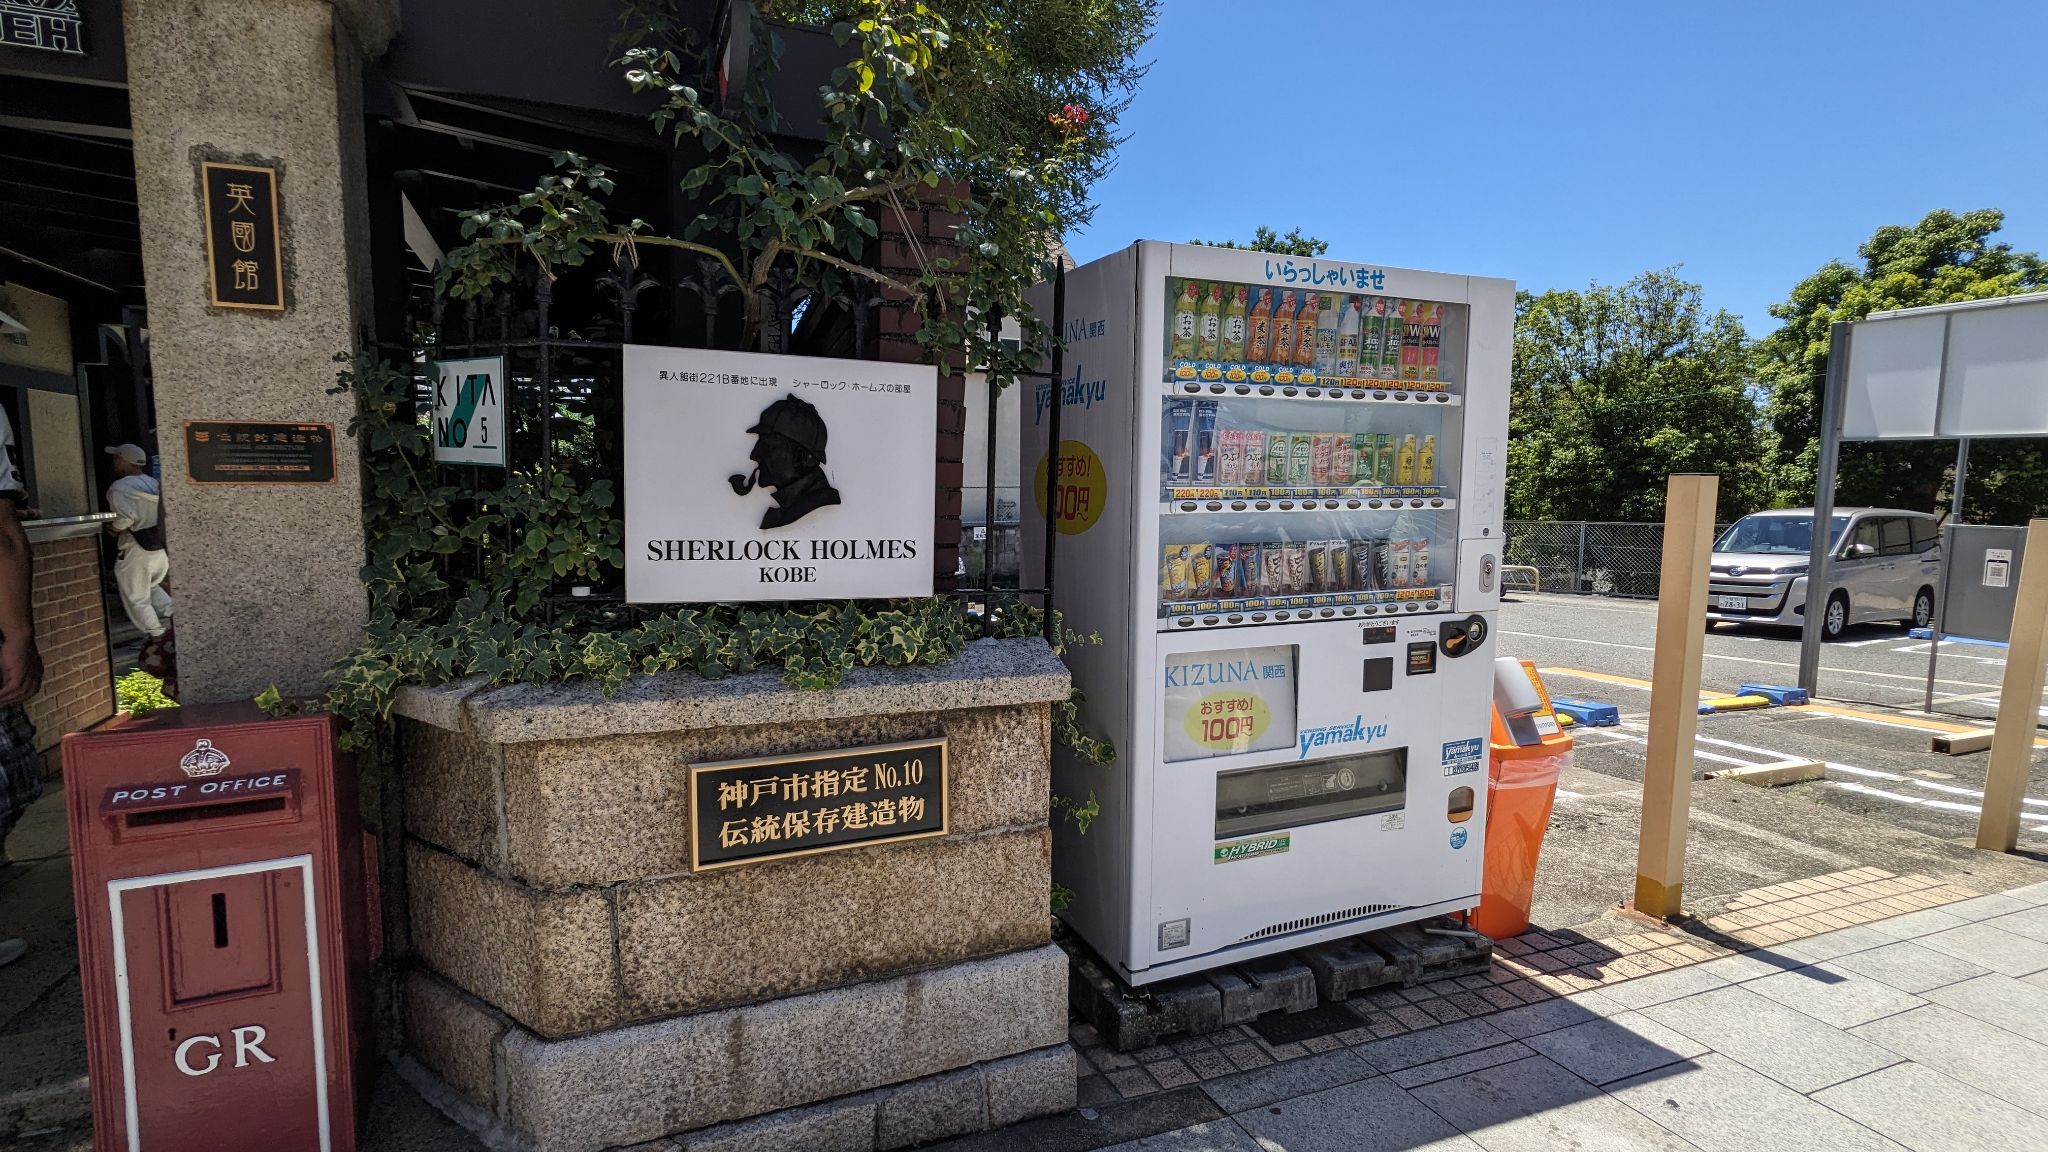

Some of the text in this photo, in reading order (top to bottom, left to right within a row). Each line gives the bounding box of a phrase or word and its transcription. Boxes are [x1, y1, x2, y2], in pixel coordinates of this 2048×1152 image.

[226, 183, 259, 291] 英國館
[1265, 260, 1385, 290] いらっしゃいませ
[438, 417, 488, 448] NO 5
[1047, 455, 1092, 477] すすめ!
[647, 538, 917, 562] SHERLOCK HOLMES
[759, 566, 817, 583] KOBE
[1165, 660, 1286, 688] KIZUNA 関西
[1200, 697, 1254, 715] おすすめ!
[1299, 715, 1388, 760] yamakyu
[112, 774, 287, 803] POST OFFICE
[717, 758, 923, 811] 神戸市指定 No.10
[717, 795, 925, 849] 伝統保存建造物
[1229, 840, 1278, 859] HYBRID
[174, 1025, 276, 1076] GR
